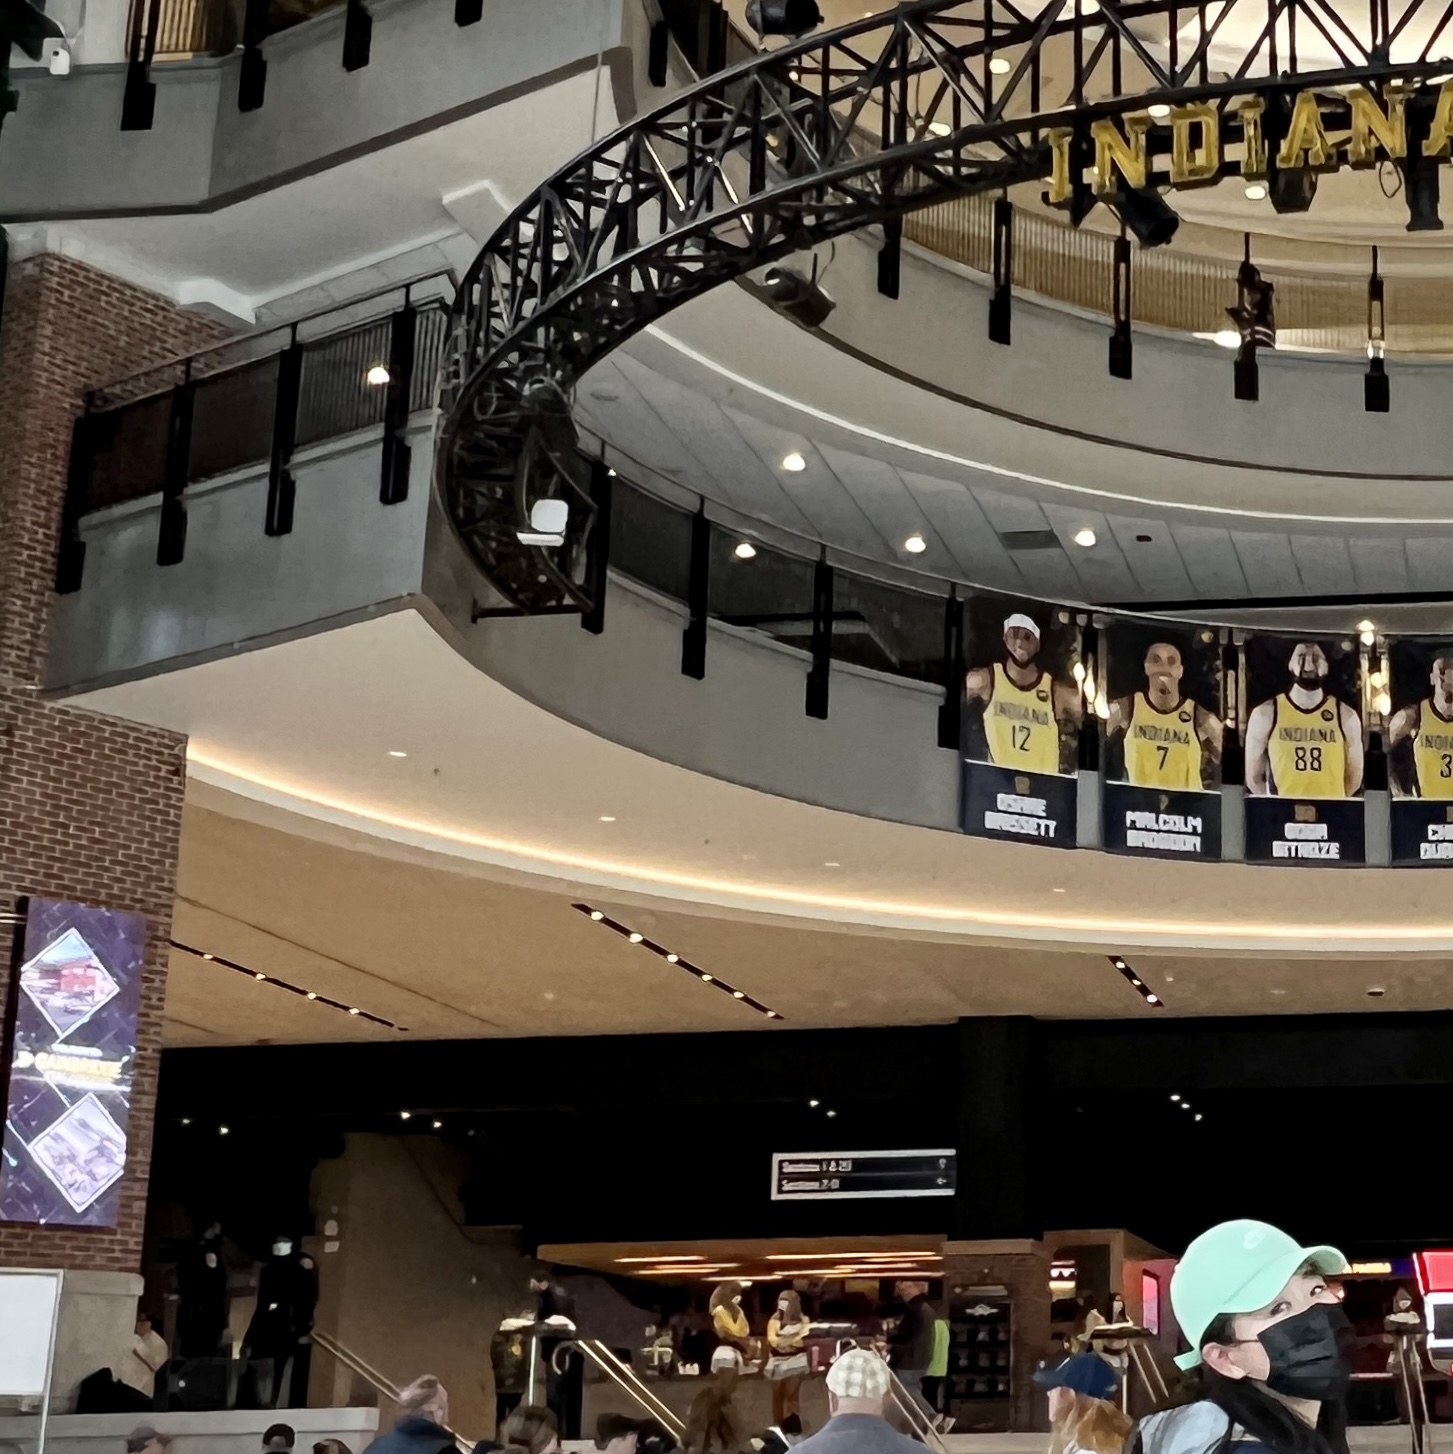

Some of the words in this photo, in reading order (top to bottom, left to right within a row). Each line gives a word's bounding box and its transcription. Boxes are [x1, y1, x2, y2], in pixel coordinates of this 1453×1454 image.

[1011, 724, 1032, 752] 12
[1156, 745, 1169, 771] 7
[1294, 746, 1322, 772] 88
[1439, 753, 1452, 779] 3
[1126, 811, 1202, 833] MALCOLM
